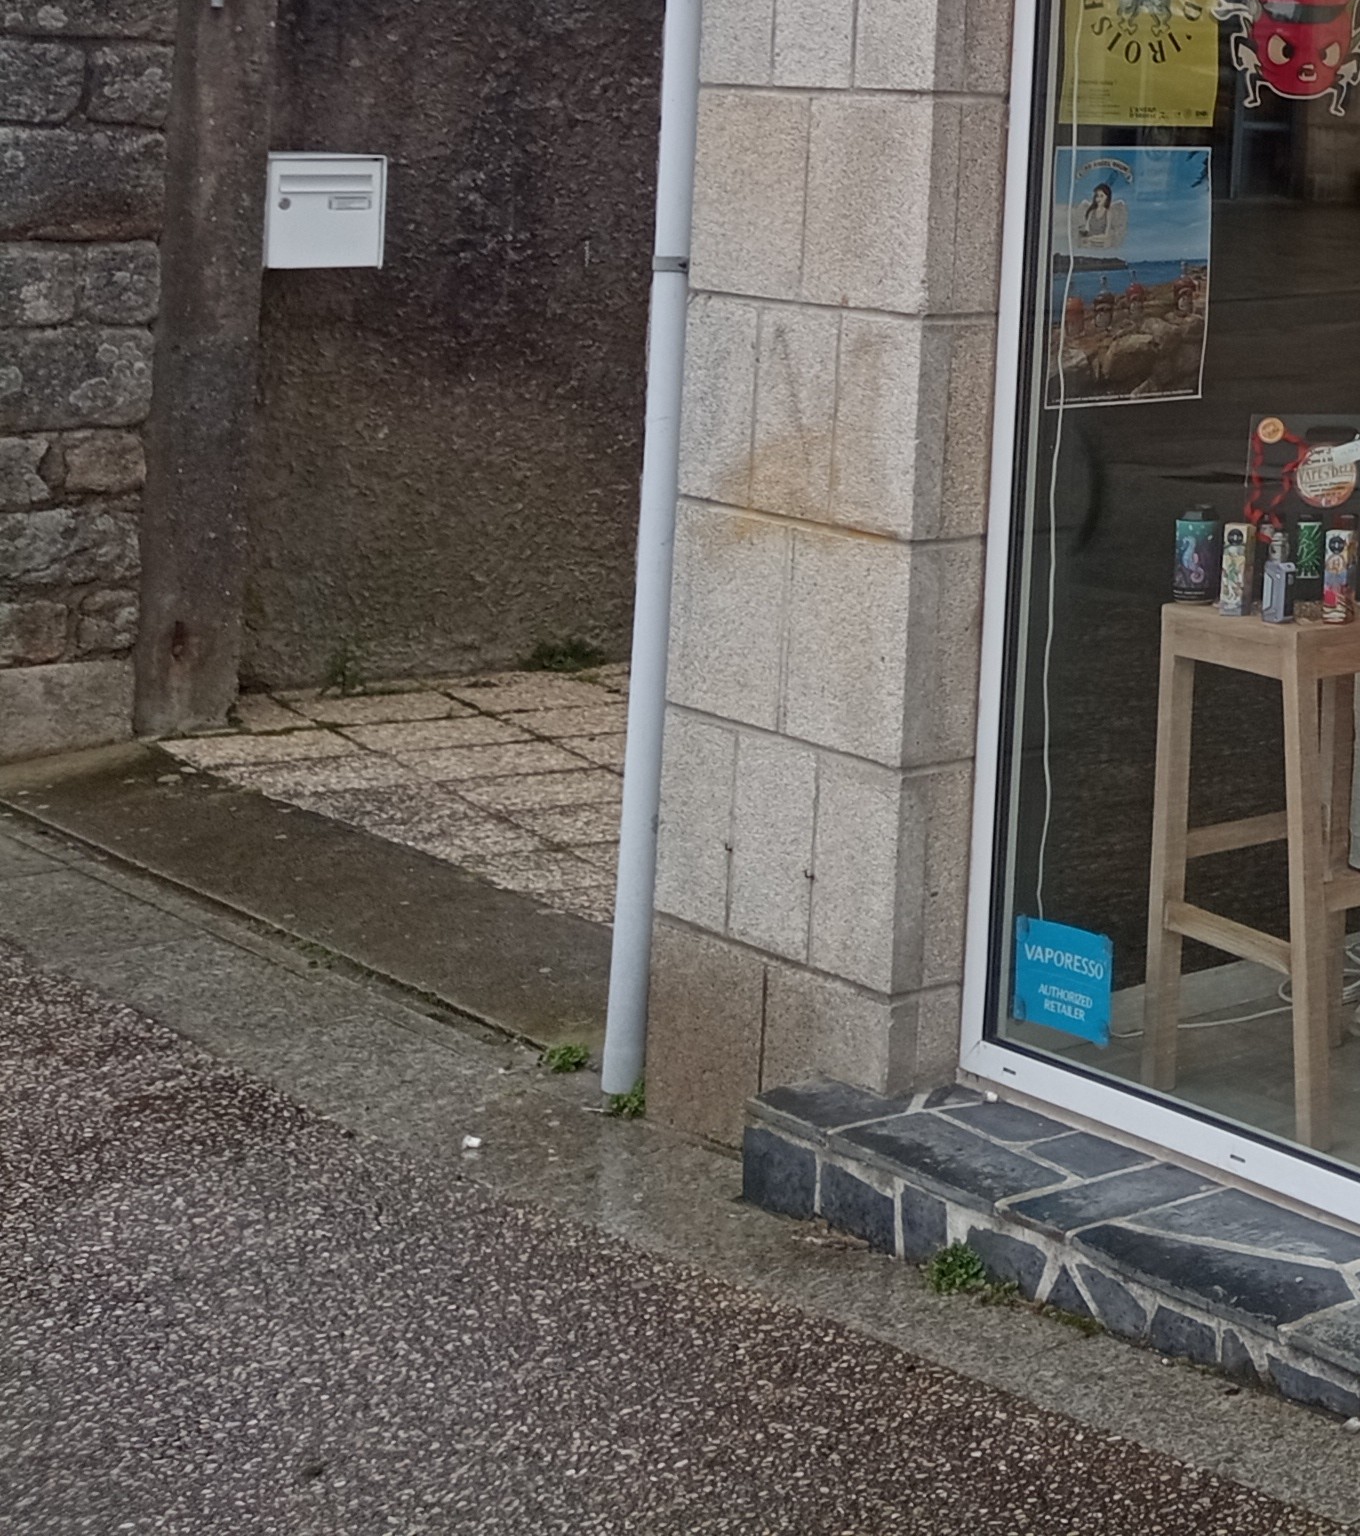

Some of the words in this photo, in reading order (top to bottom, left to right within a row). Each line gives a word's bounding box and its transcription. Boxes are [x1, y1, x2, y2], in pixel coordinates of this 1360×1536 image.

[1024, 943, 1104, 980] VAPORESSO
[1038, 983, 1093, 1009] AUTHORIZED
[1043, 999, 1085, 1021] RETAILER
